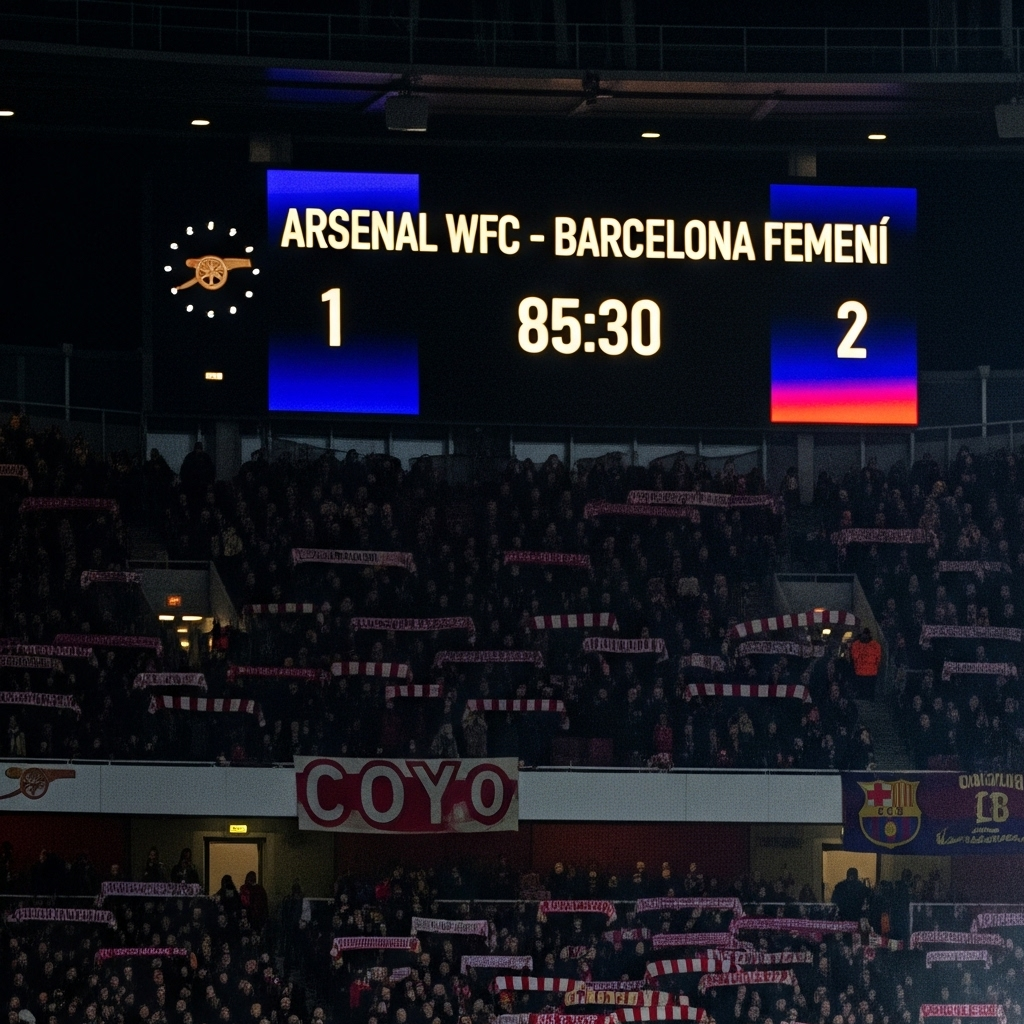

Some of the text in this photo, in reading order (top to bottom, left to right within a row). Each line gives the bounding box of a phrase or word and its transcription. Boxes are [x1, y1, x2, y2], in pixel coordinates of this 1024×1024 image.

[280, 206, 438, 253] ARSENAL
[445, 213, 520, 255] WFC
[555, 216, 756, 262] BARCELONA
[764, 215, 890, 265] FEMENÍ
[321, 287, 341, 347] 1
[517, 296, 661, 356] 85:30
[836, 300, 868, 359] 2
[305, 762, 507, 826] COYO
